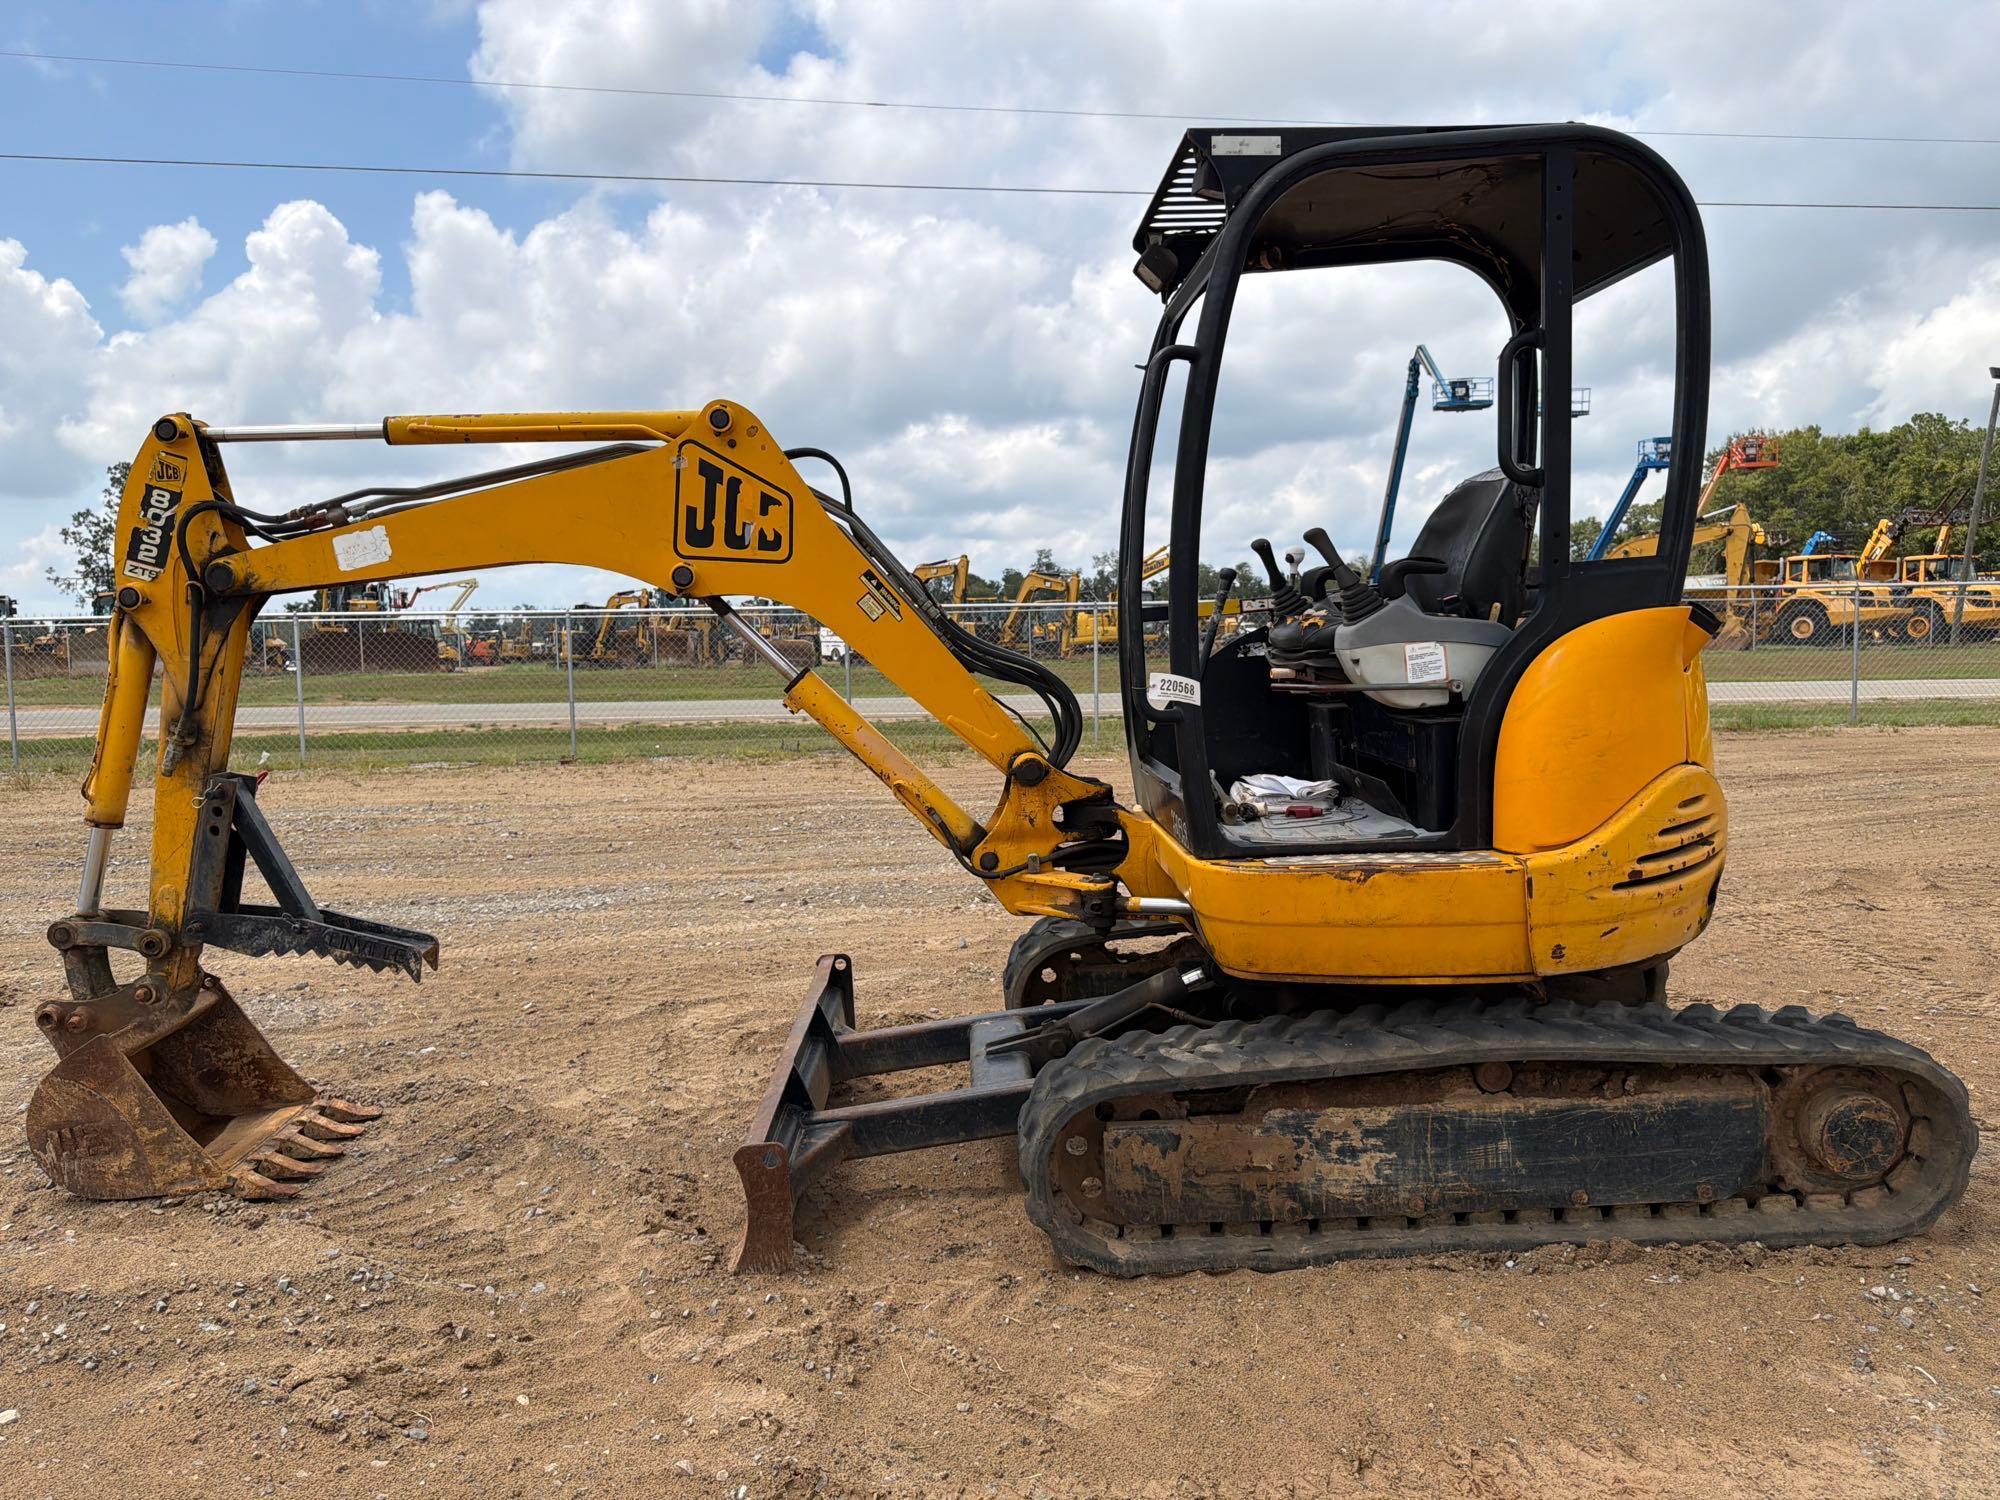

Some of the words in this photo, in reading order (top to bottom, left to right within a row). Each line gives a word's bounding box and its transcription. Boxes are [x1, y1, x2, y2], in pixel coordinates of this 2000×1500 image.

[157, 461, 180, 481] JCB
[137, 488, 171, 565] 8032
[1159, 678, 1195, 696] 220568
